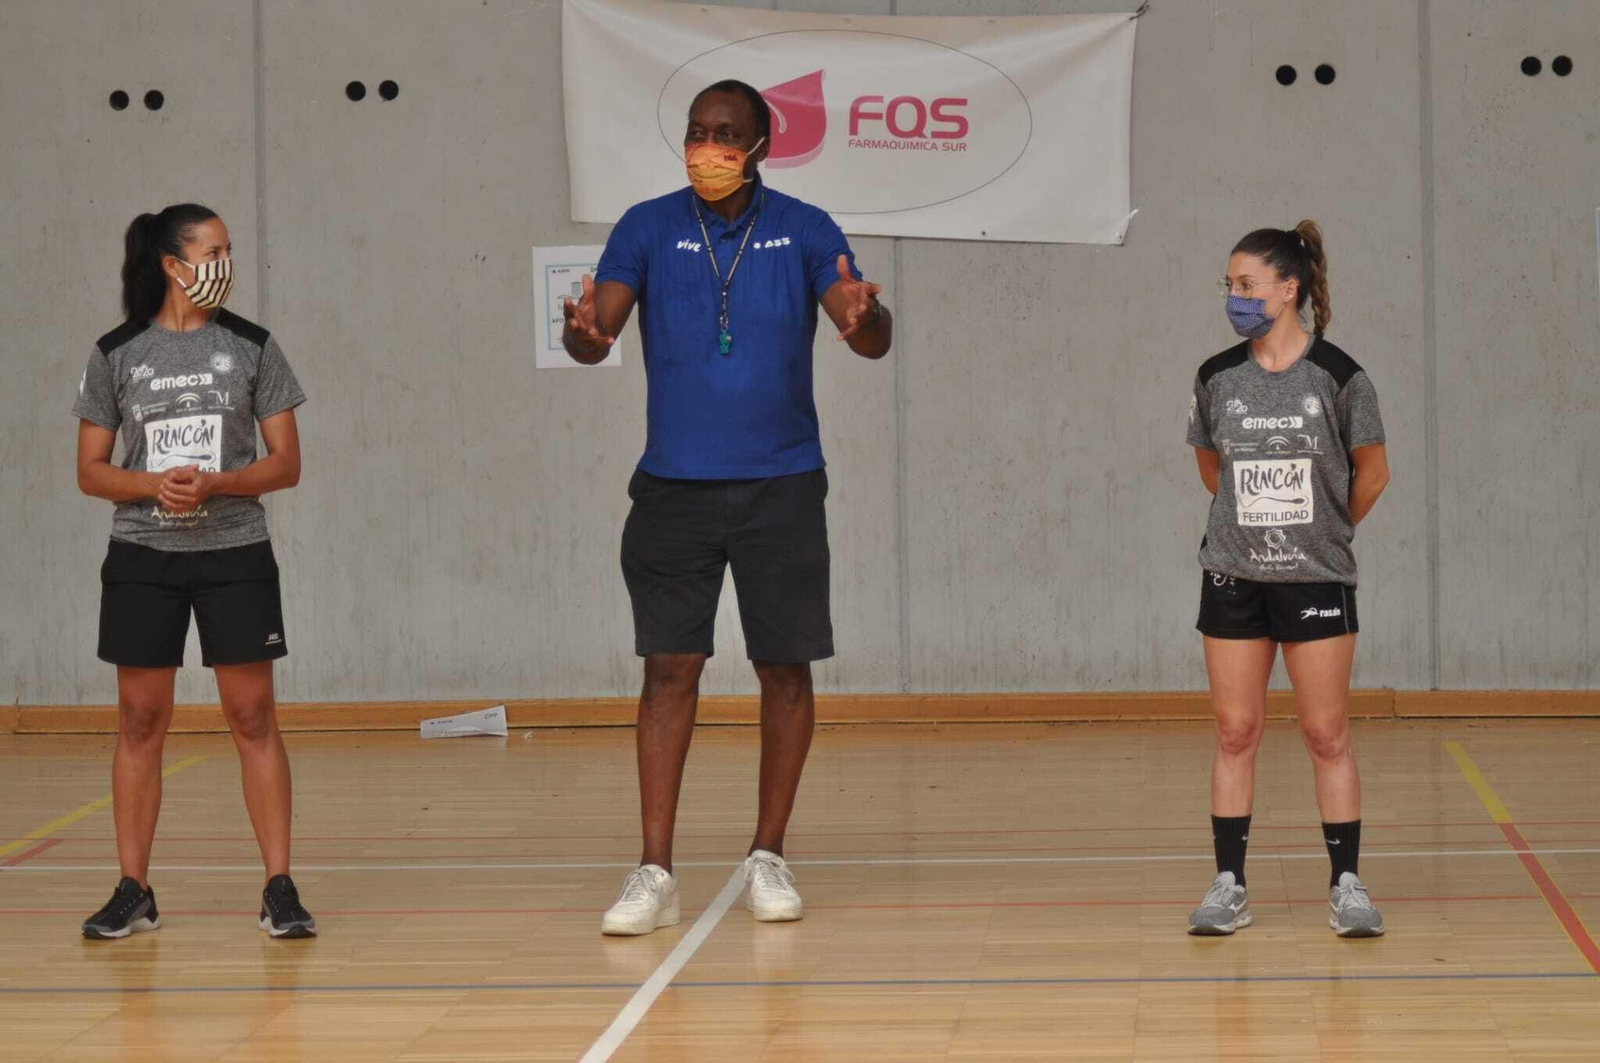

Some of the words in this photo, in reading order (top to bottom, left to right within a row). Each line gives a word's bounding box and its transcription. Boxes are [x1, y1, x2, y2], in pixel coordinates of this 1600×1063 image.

[848, 95, 969, 139] FQS
[848, 138, 938, 151] FARMAQUIMICA
[941, 142, 967, 152] SUR
[1242, 509, 1309, 523] FERTILIDAD
